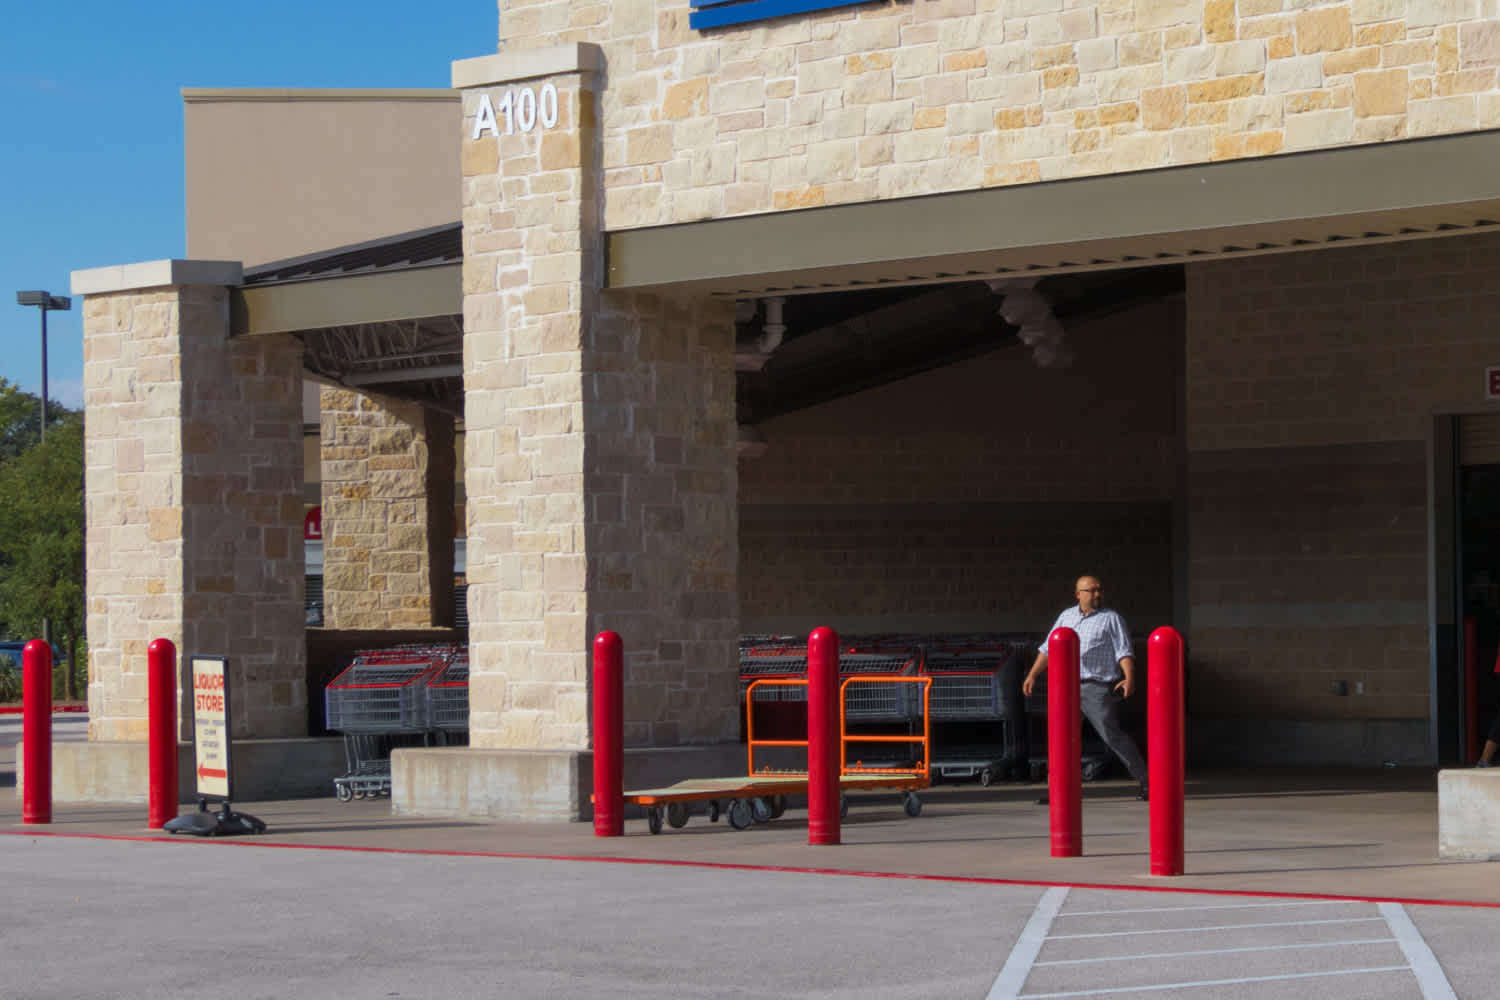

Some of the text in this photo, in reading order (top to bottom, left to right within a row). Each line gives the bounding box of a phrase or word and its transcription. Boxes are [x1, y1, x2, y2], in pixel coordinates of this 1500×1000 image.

[472, 83, 558, 140] A100
[193, 673, 225, 691] LIQUOR
[196, 694, 224, 712] STORE
